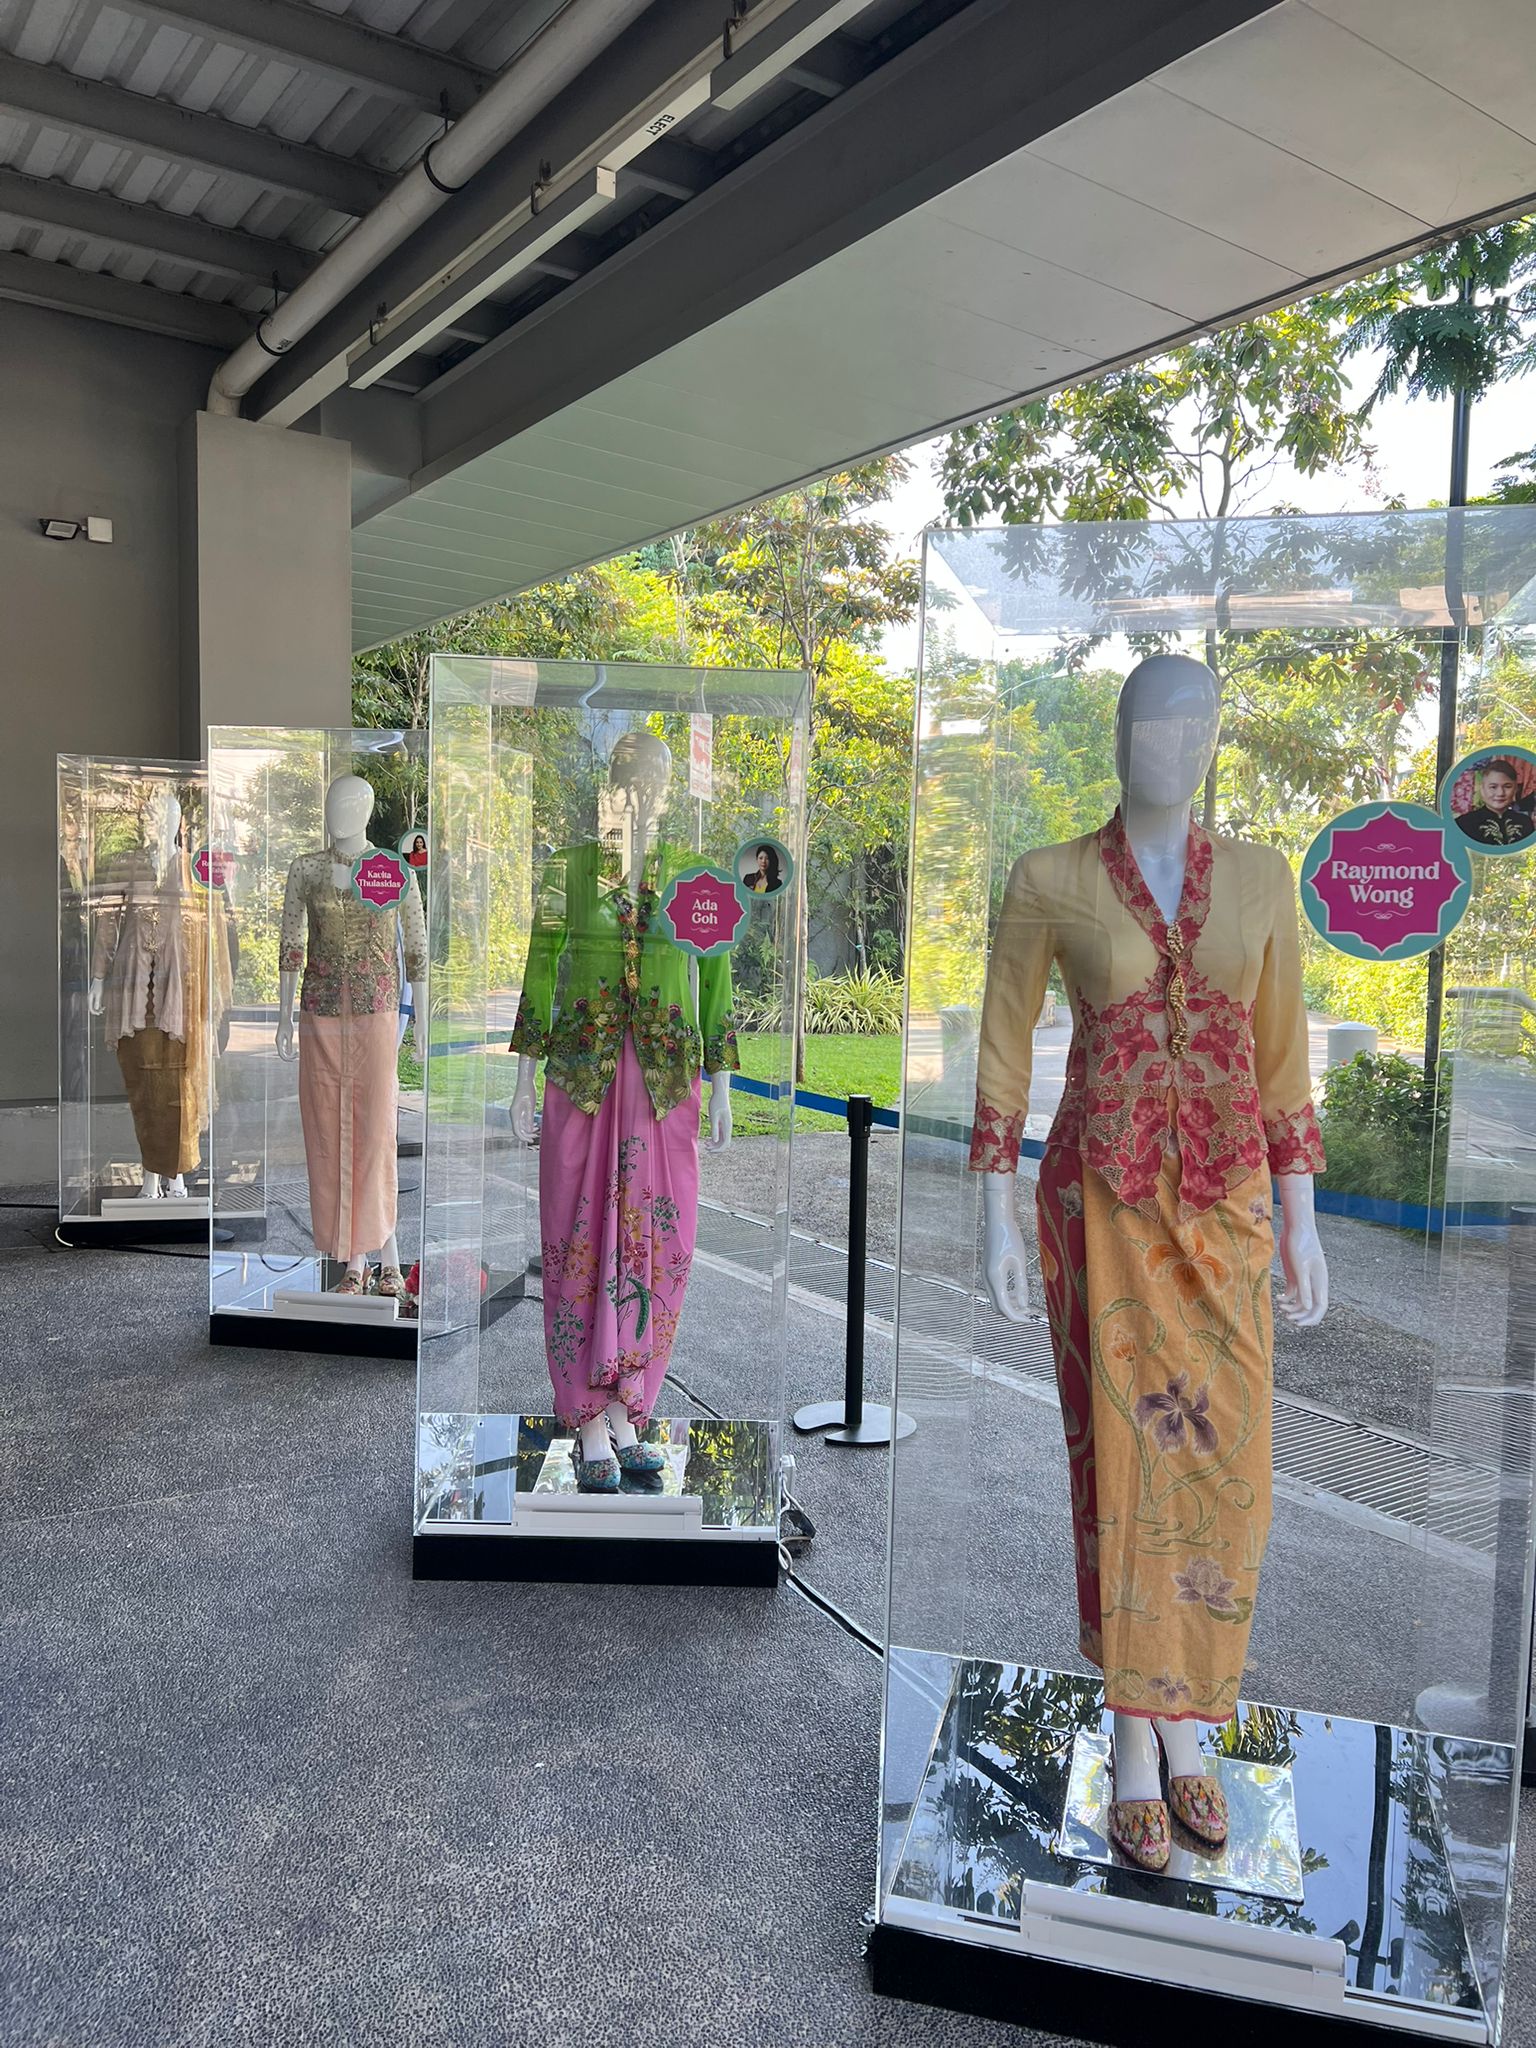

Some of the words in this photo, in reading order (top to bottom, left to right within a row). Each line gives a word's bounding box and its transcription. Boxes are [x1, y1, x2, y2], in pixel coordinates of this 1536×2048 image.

[646, 114, 676, 136] ELECT
[367, 870, 392, 879] Kavita
[1331, 860, 1440, 884] Raymond
[358, 878, 401, 888] Thulasidas
[1348, 884, 1415, 908] Wong
[692, 898, 718, 911] Ada
[691, 912, 718, 925] Goh
